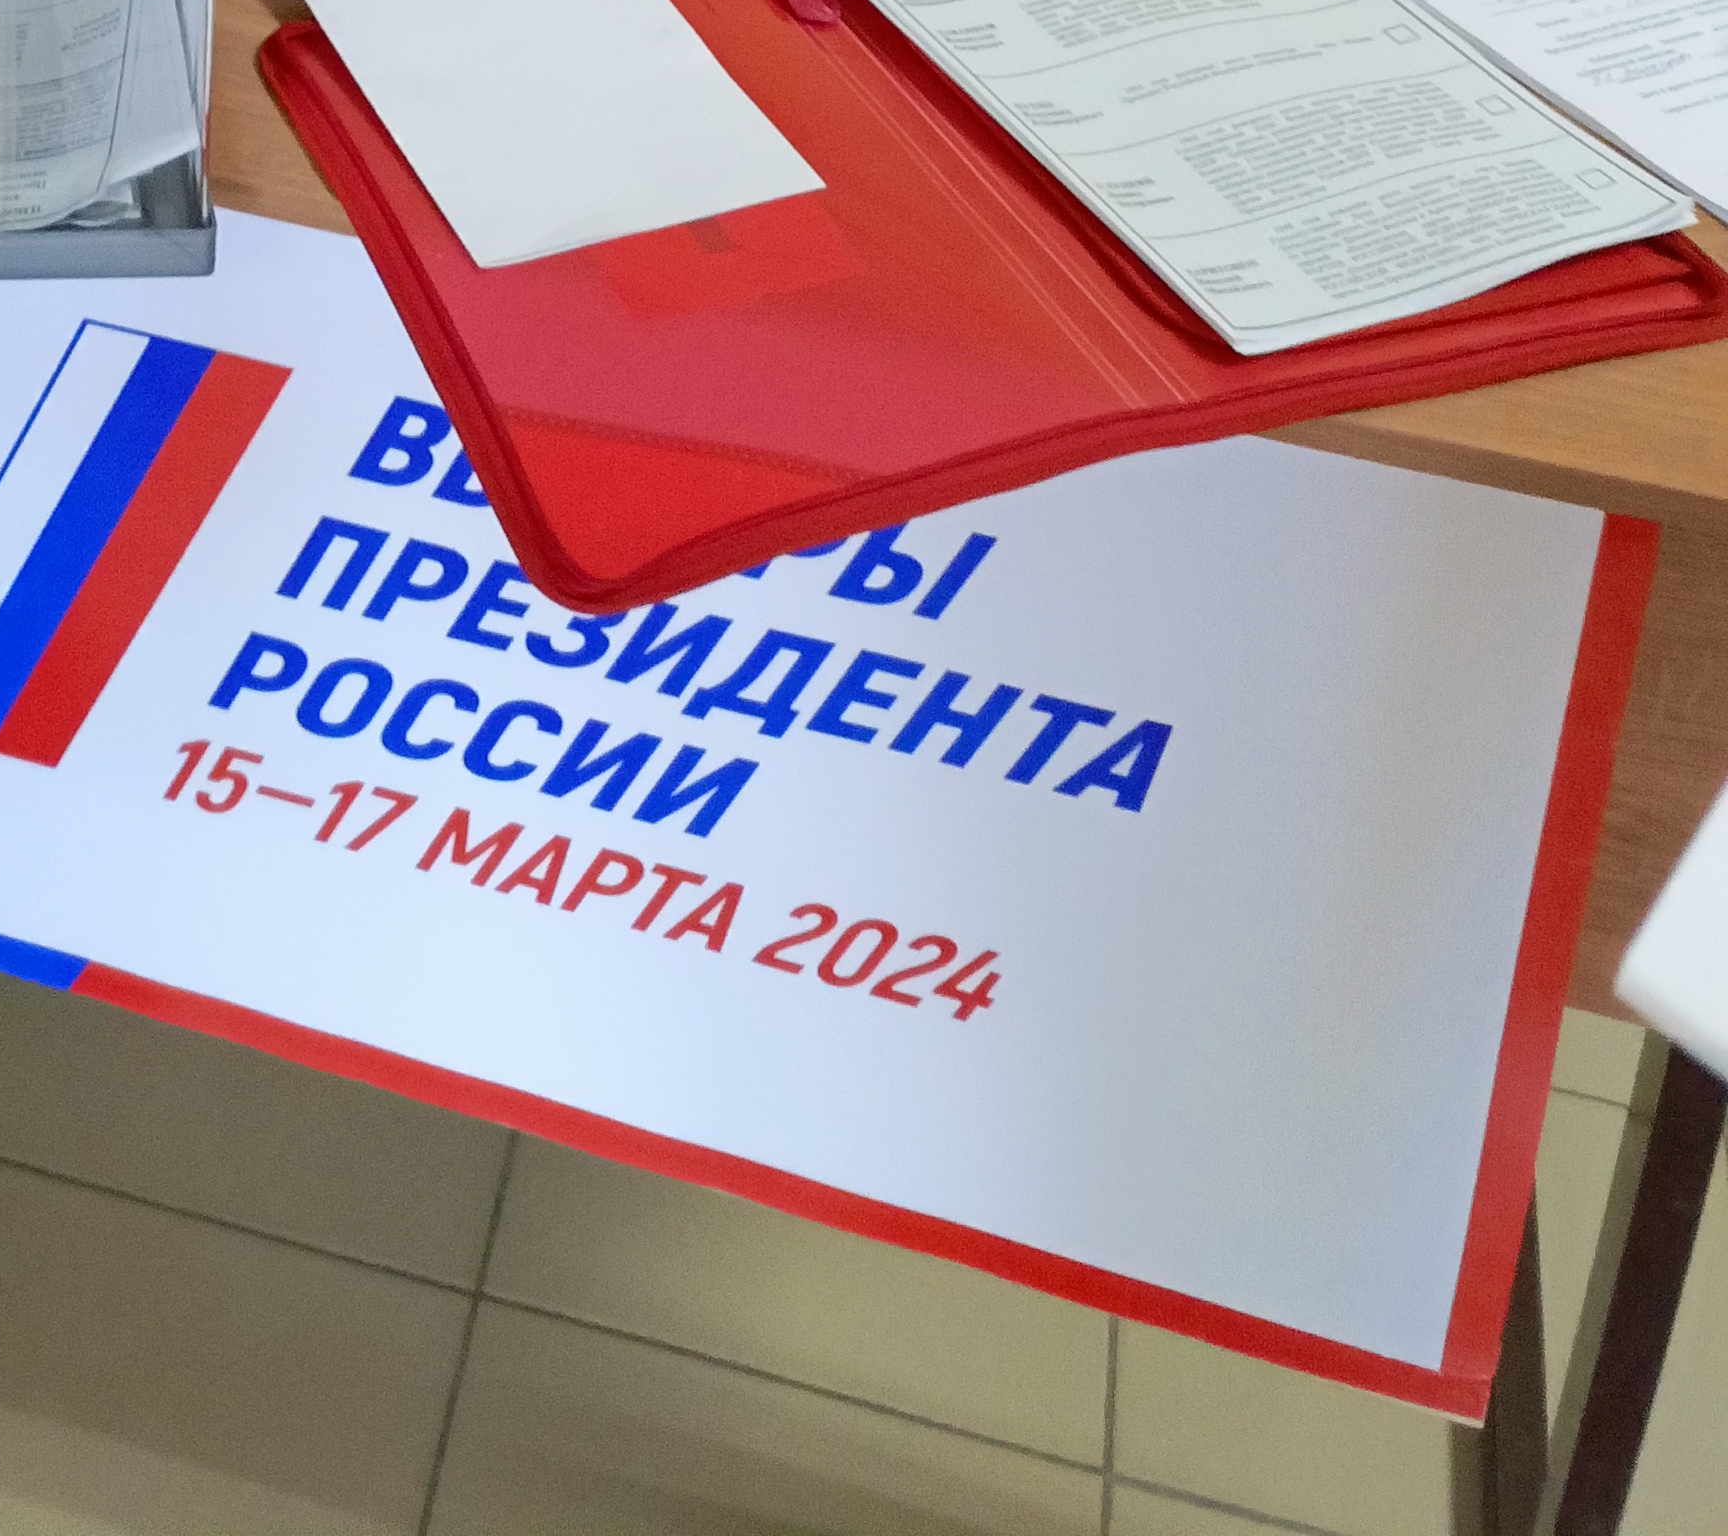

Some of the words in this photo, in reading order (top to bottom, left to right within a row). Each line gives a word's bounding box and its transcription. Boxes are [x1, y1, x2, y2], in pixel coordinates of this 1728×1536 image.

[208, 632, 759, 839] РОССИИ
[277, 517, 1173, 812] ПРЕЗИДЕНТА
[416, 807, 745, 952] МАРТА
[754, 902, 1002, 1021] 2024
